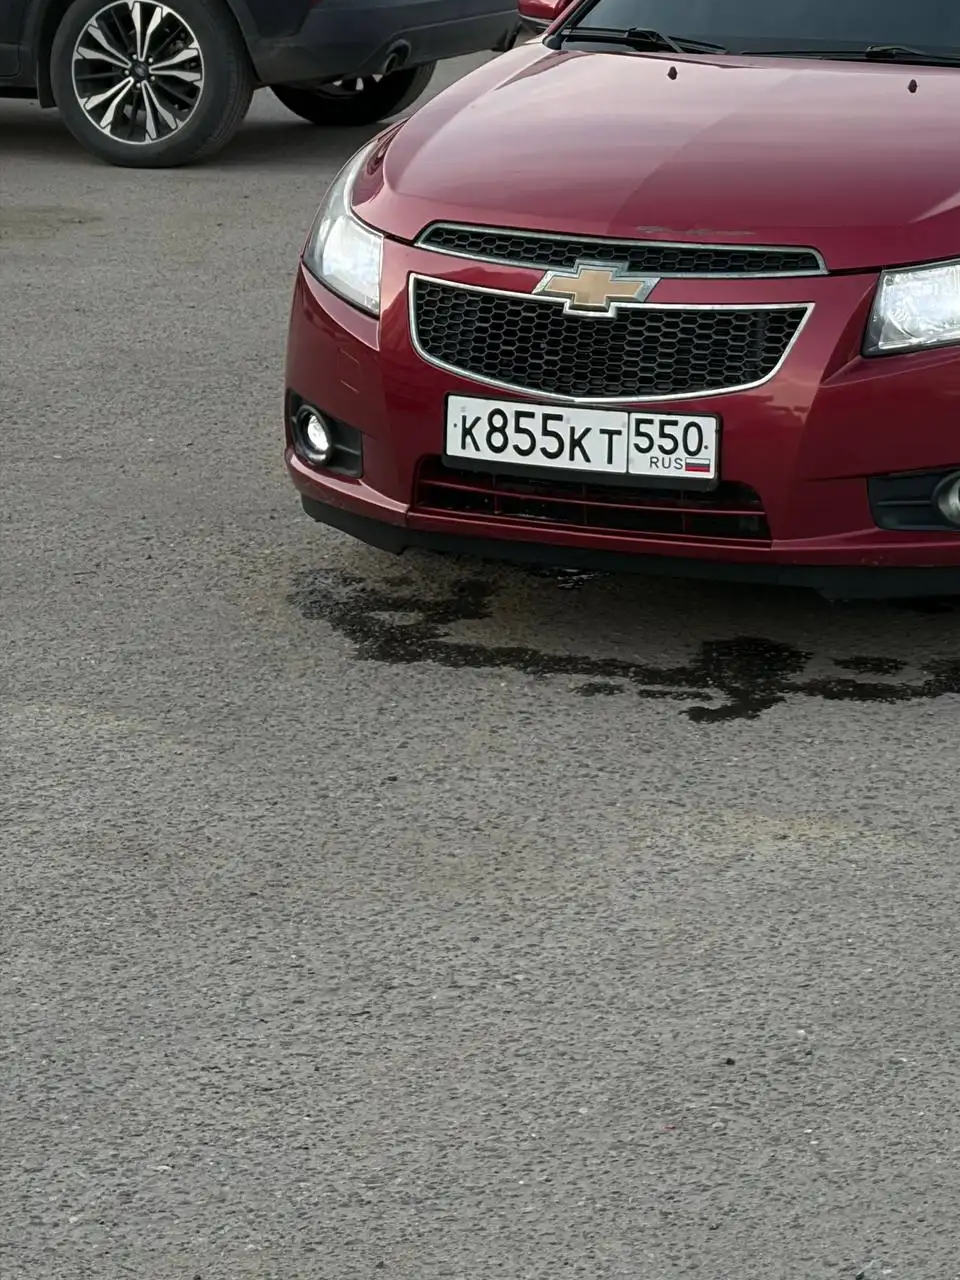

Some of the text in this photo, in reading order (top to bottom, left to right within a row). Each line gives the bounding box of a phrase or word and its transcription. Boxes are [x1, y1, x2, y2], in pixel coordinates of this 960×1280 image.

[460, 407, 704, 465] К855КТ 550
[650, 455, 684, 470] RUS
